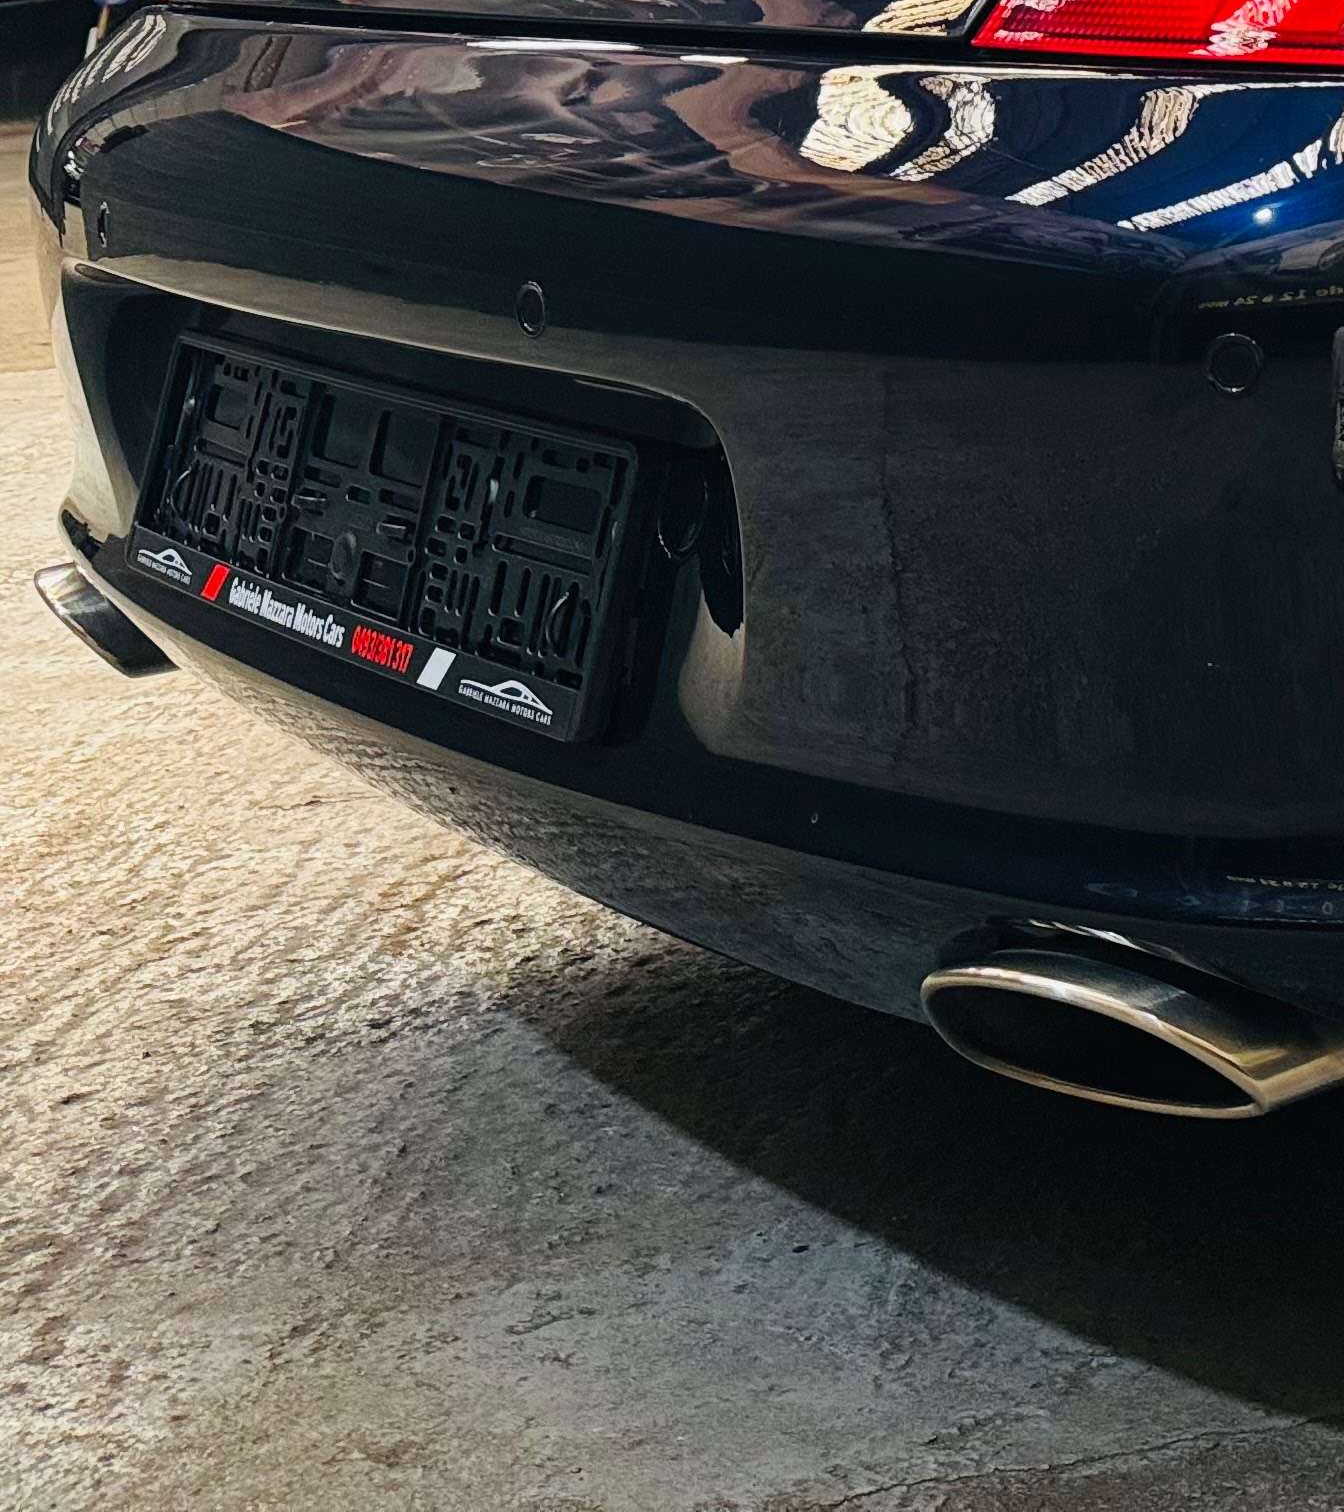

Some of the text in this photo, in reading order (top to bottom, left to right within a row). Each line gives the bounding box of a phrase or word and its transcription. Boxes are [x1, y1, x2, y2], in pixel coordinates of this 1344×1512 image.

[228, 576, 262, 616] Gabriele
[259, 588, 295, 629] Mazzara
[291, 602, 325, 640] Motors
[322, 613, 346, 648] Cars
